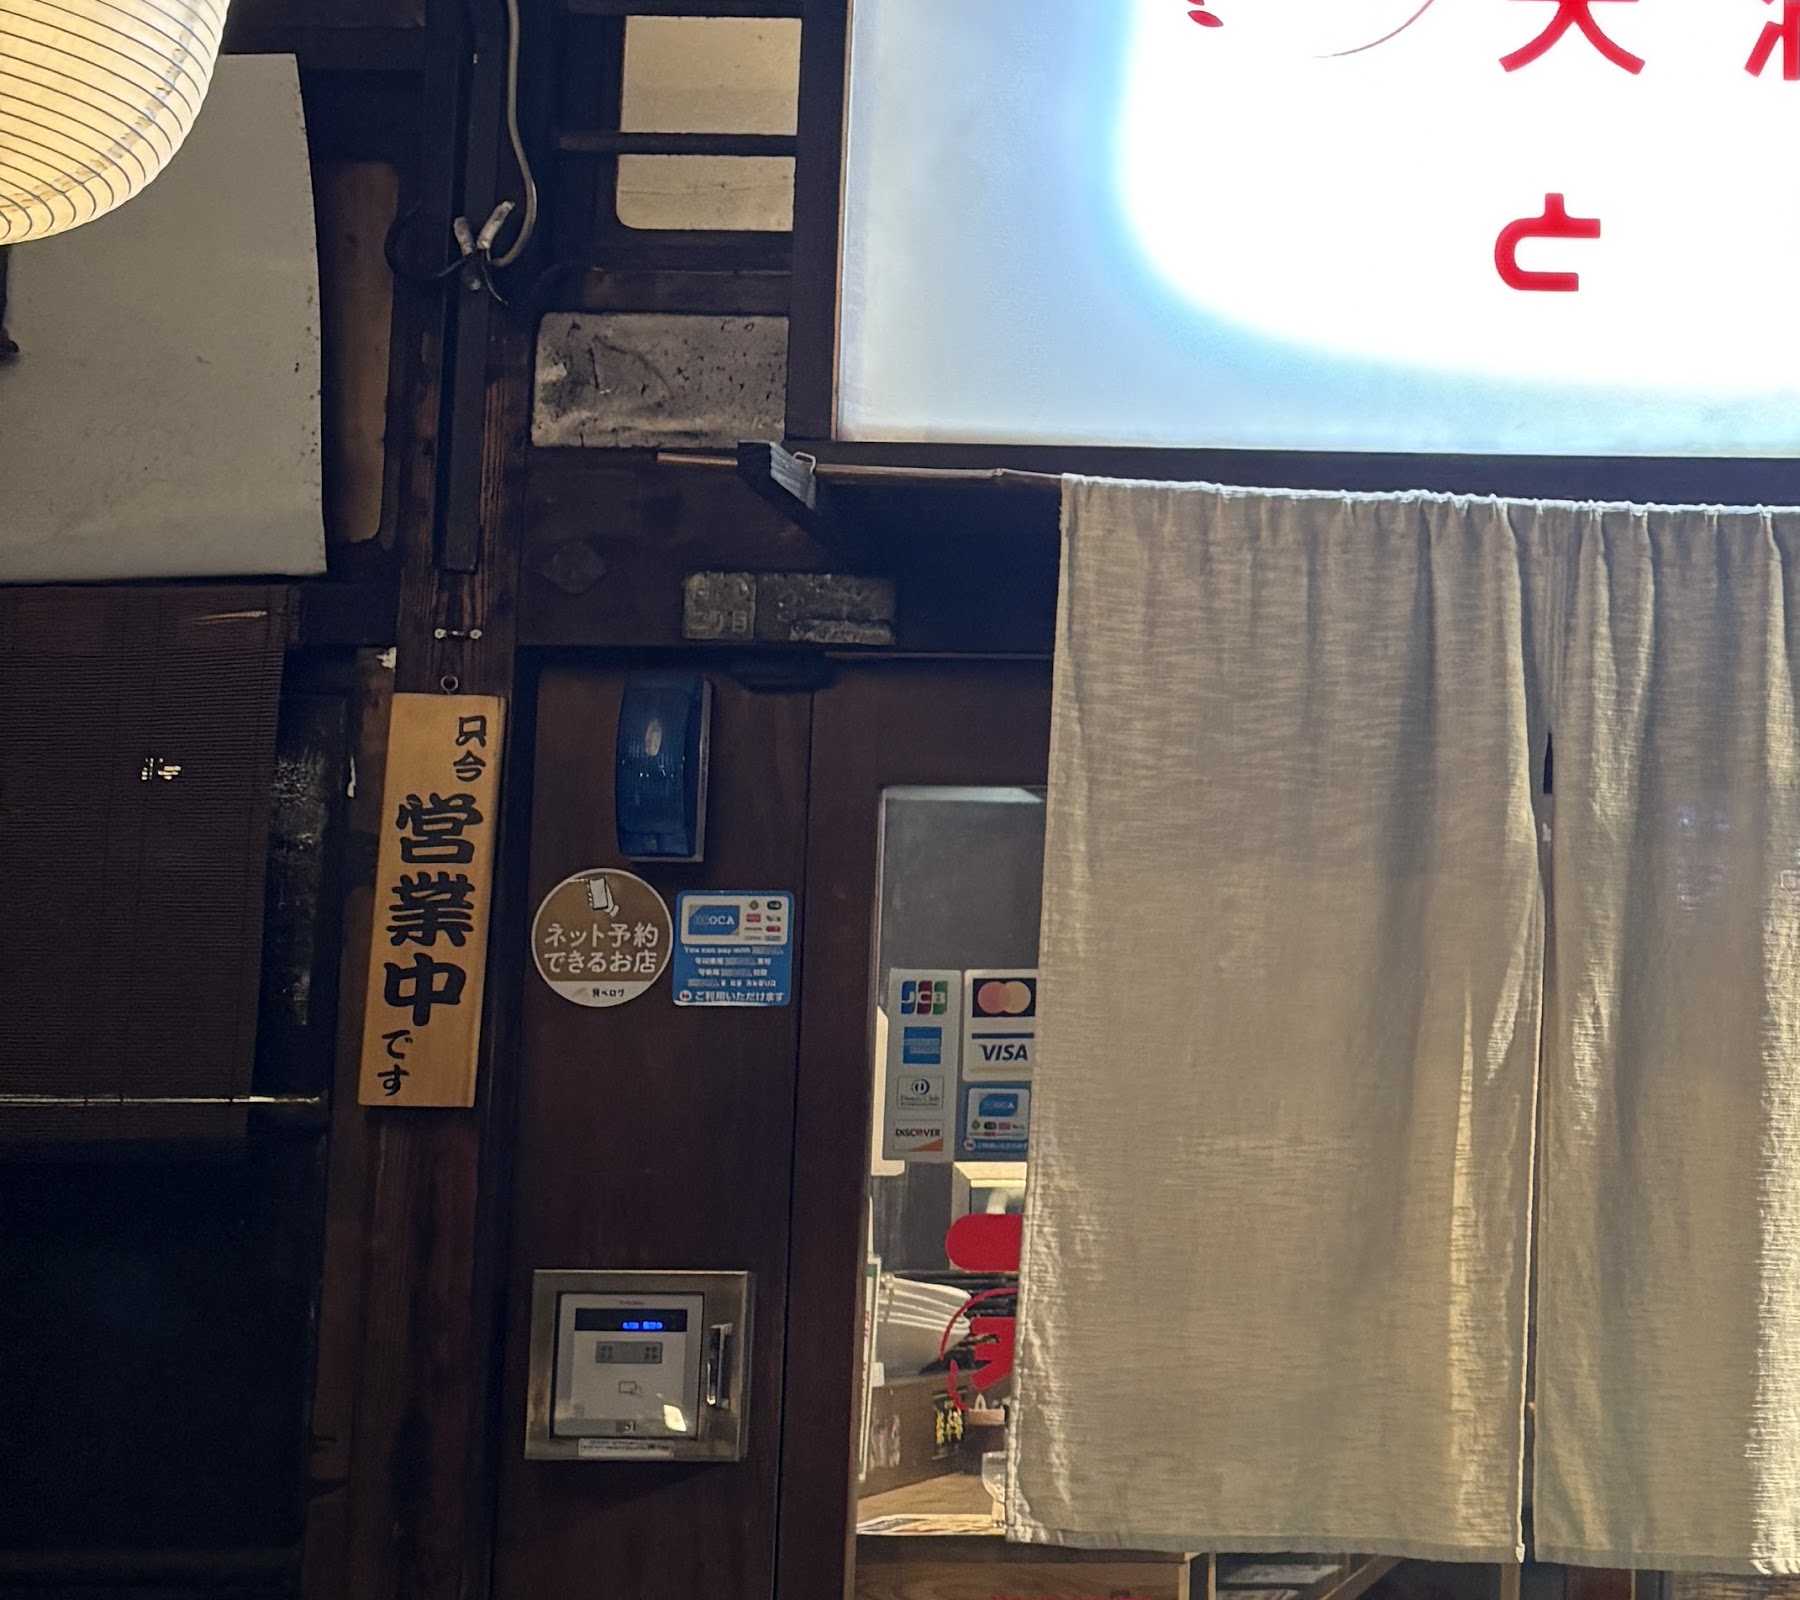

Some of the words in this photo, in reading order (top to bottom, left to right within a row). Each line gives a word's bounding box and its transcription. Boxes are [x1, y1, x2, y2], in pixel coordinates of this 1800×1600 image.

[544, 921, 659, 948] ネット予約
[543, 948, 658, 974] できるお店
[900, 980, 949, 1015] JCB
[980, 1044, 1029, 1061] VISA
[895, 1128, 941, 1138] DISCOVER
